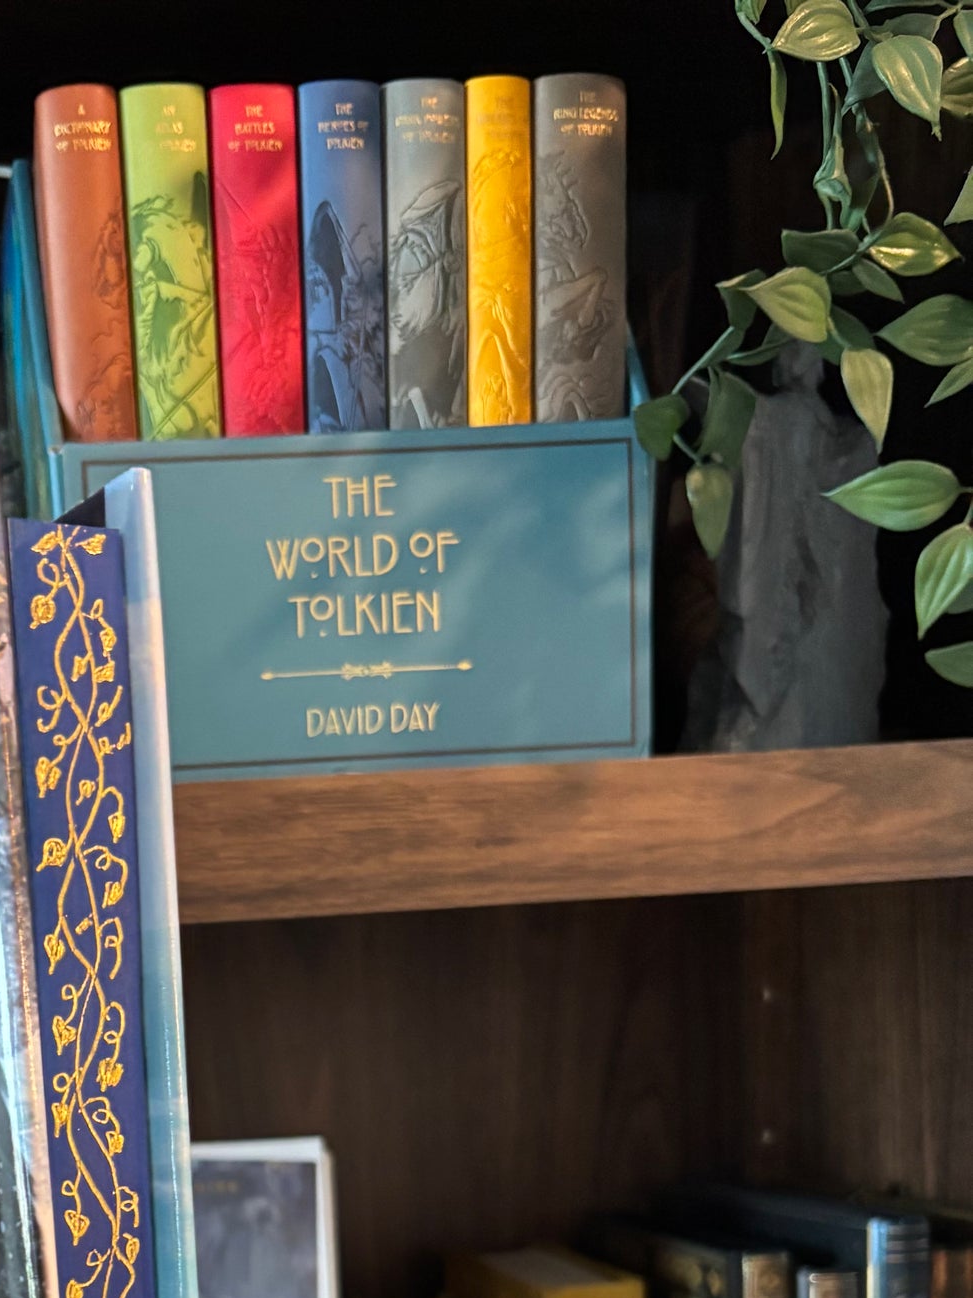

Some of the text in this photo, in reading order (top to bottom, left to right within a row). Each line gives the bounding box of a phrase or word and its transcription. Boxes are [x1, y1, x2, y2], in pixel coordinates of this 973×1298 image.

[323, 474, 397, 519] THE
[266, 529, 461, 581] WORLD OF
[288, 591, 441, 639] TOLKIEN
[306, 701, 441, 738] DAVID DAY
